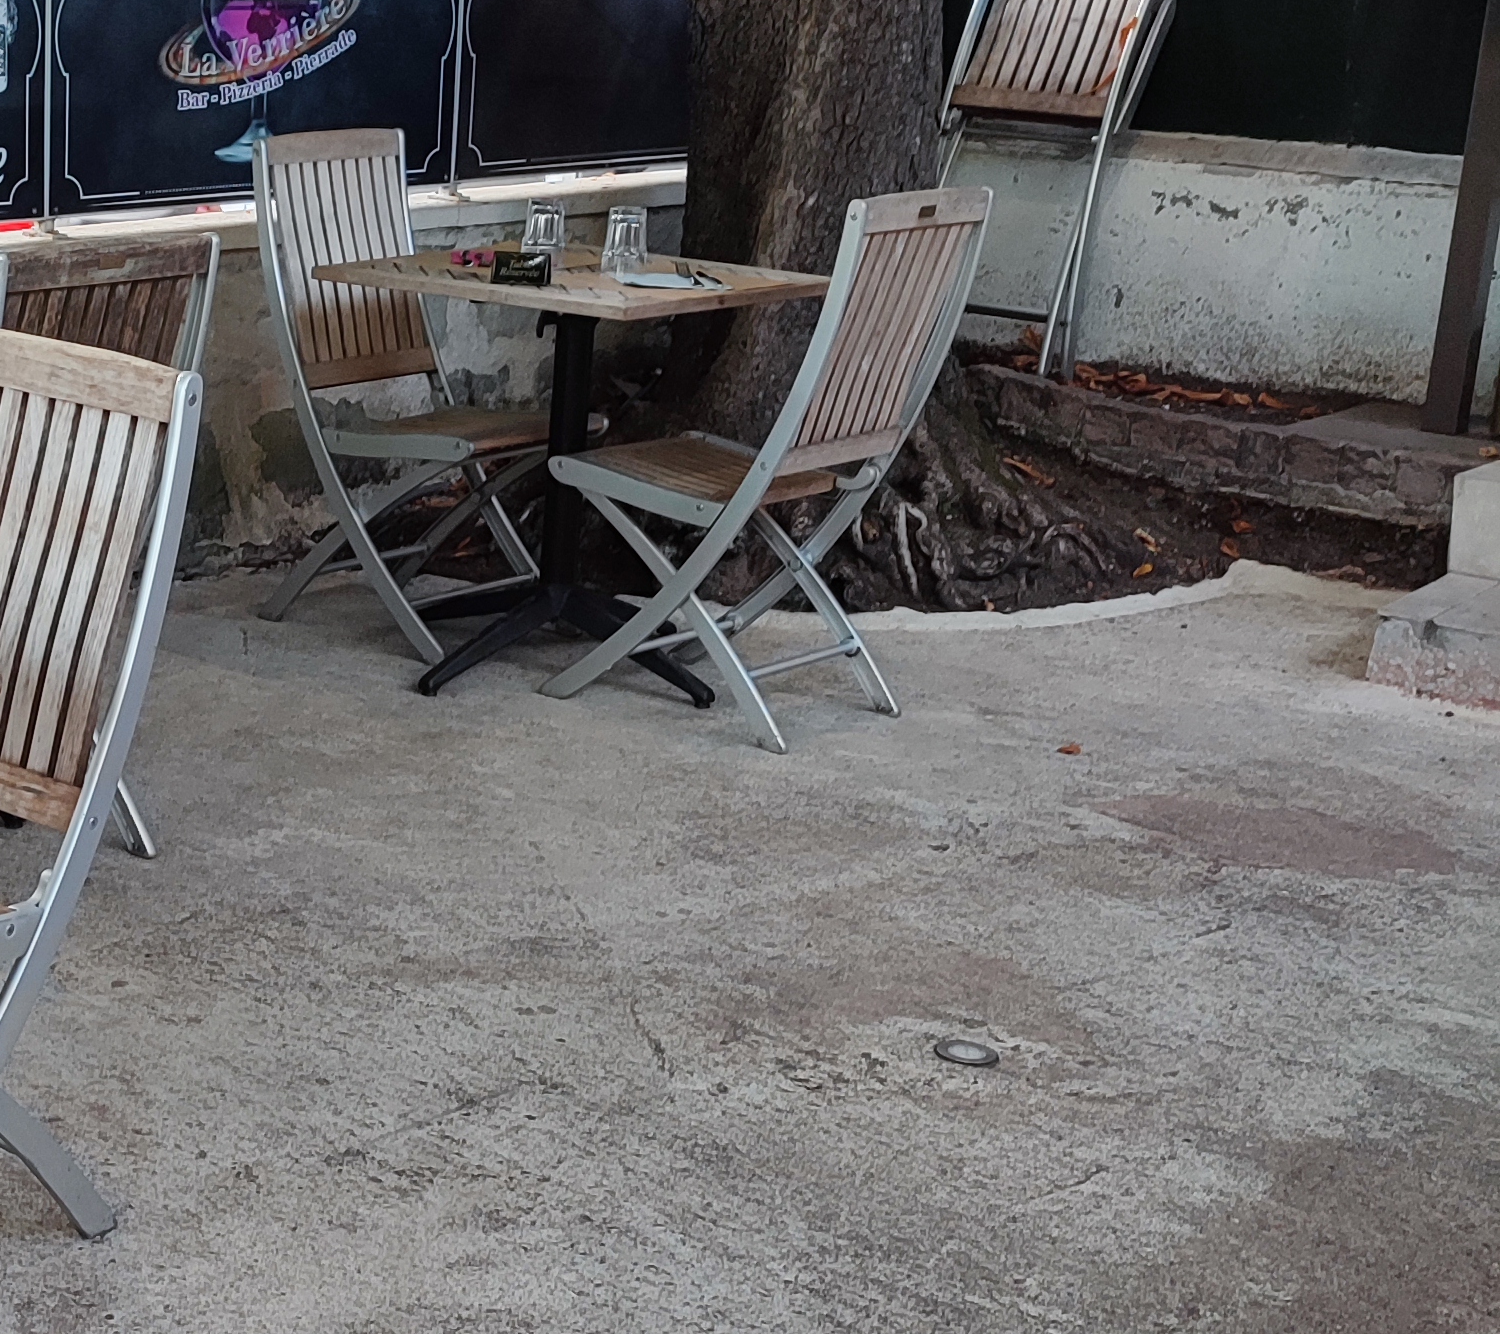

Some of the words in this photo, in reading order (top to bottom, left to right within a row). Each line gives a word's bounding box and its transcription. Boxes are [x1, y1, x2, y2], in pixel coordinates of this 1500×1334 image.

[177, 89, 209, 111] Bar
[219, 71, 284, 105] Pizzeria
[291, 28, 358, 80] Pierrade
[178, 43, 218, 77] La
